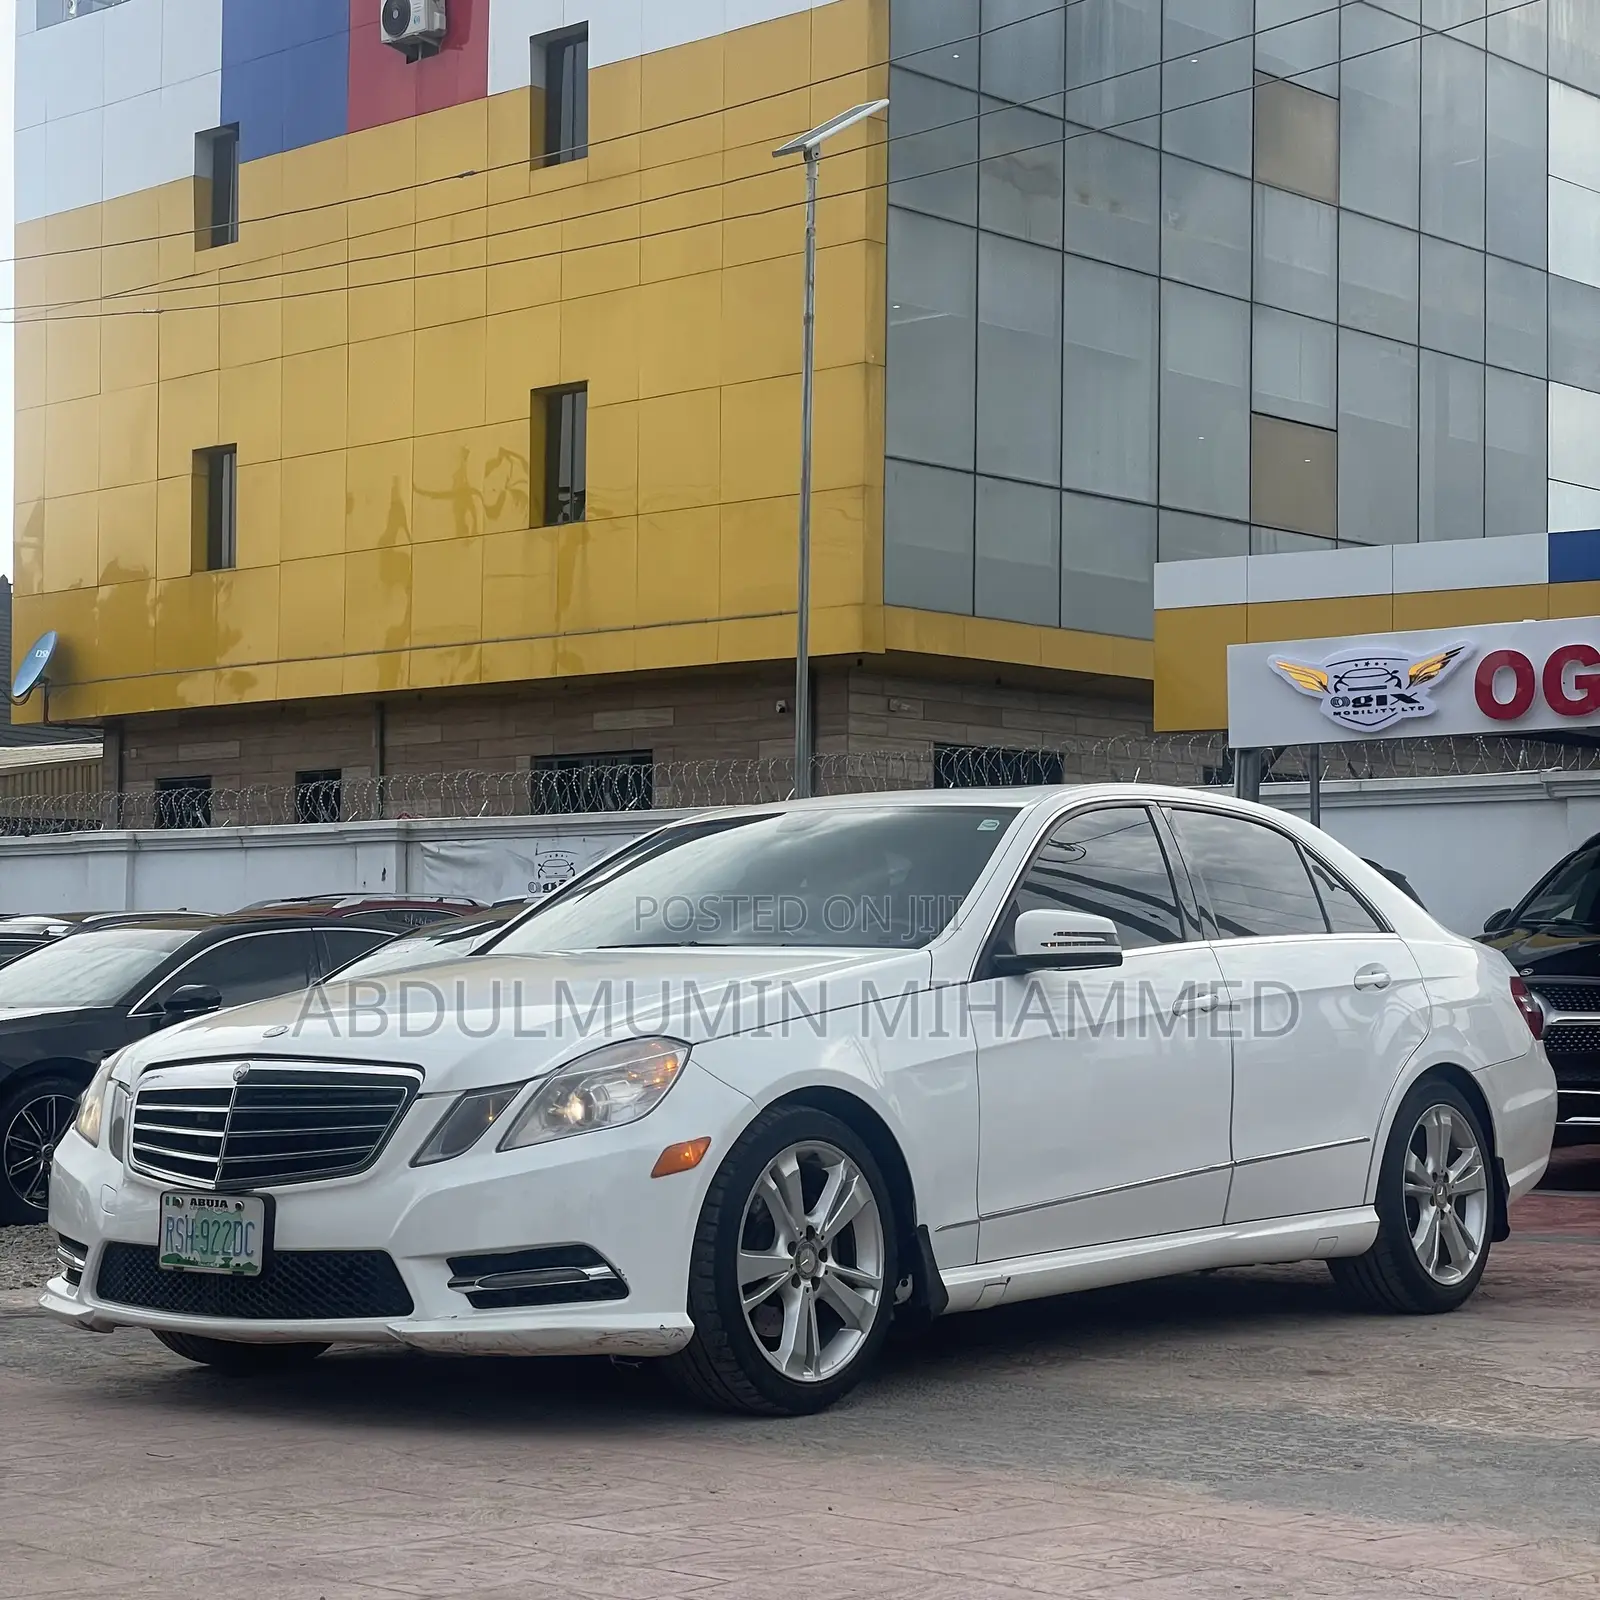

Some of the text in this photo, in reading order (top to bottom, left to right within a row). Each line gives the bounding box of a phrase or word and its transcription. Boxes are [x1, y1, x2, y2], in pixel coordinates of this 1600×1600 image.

[1475, 644, 1600, 721] OG
[1332, 707, 1397, 716] MOBILITY
[190, 1197, 229, 1208] ABUJA
